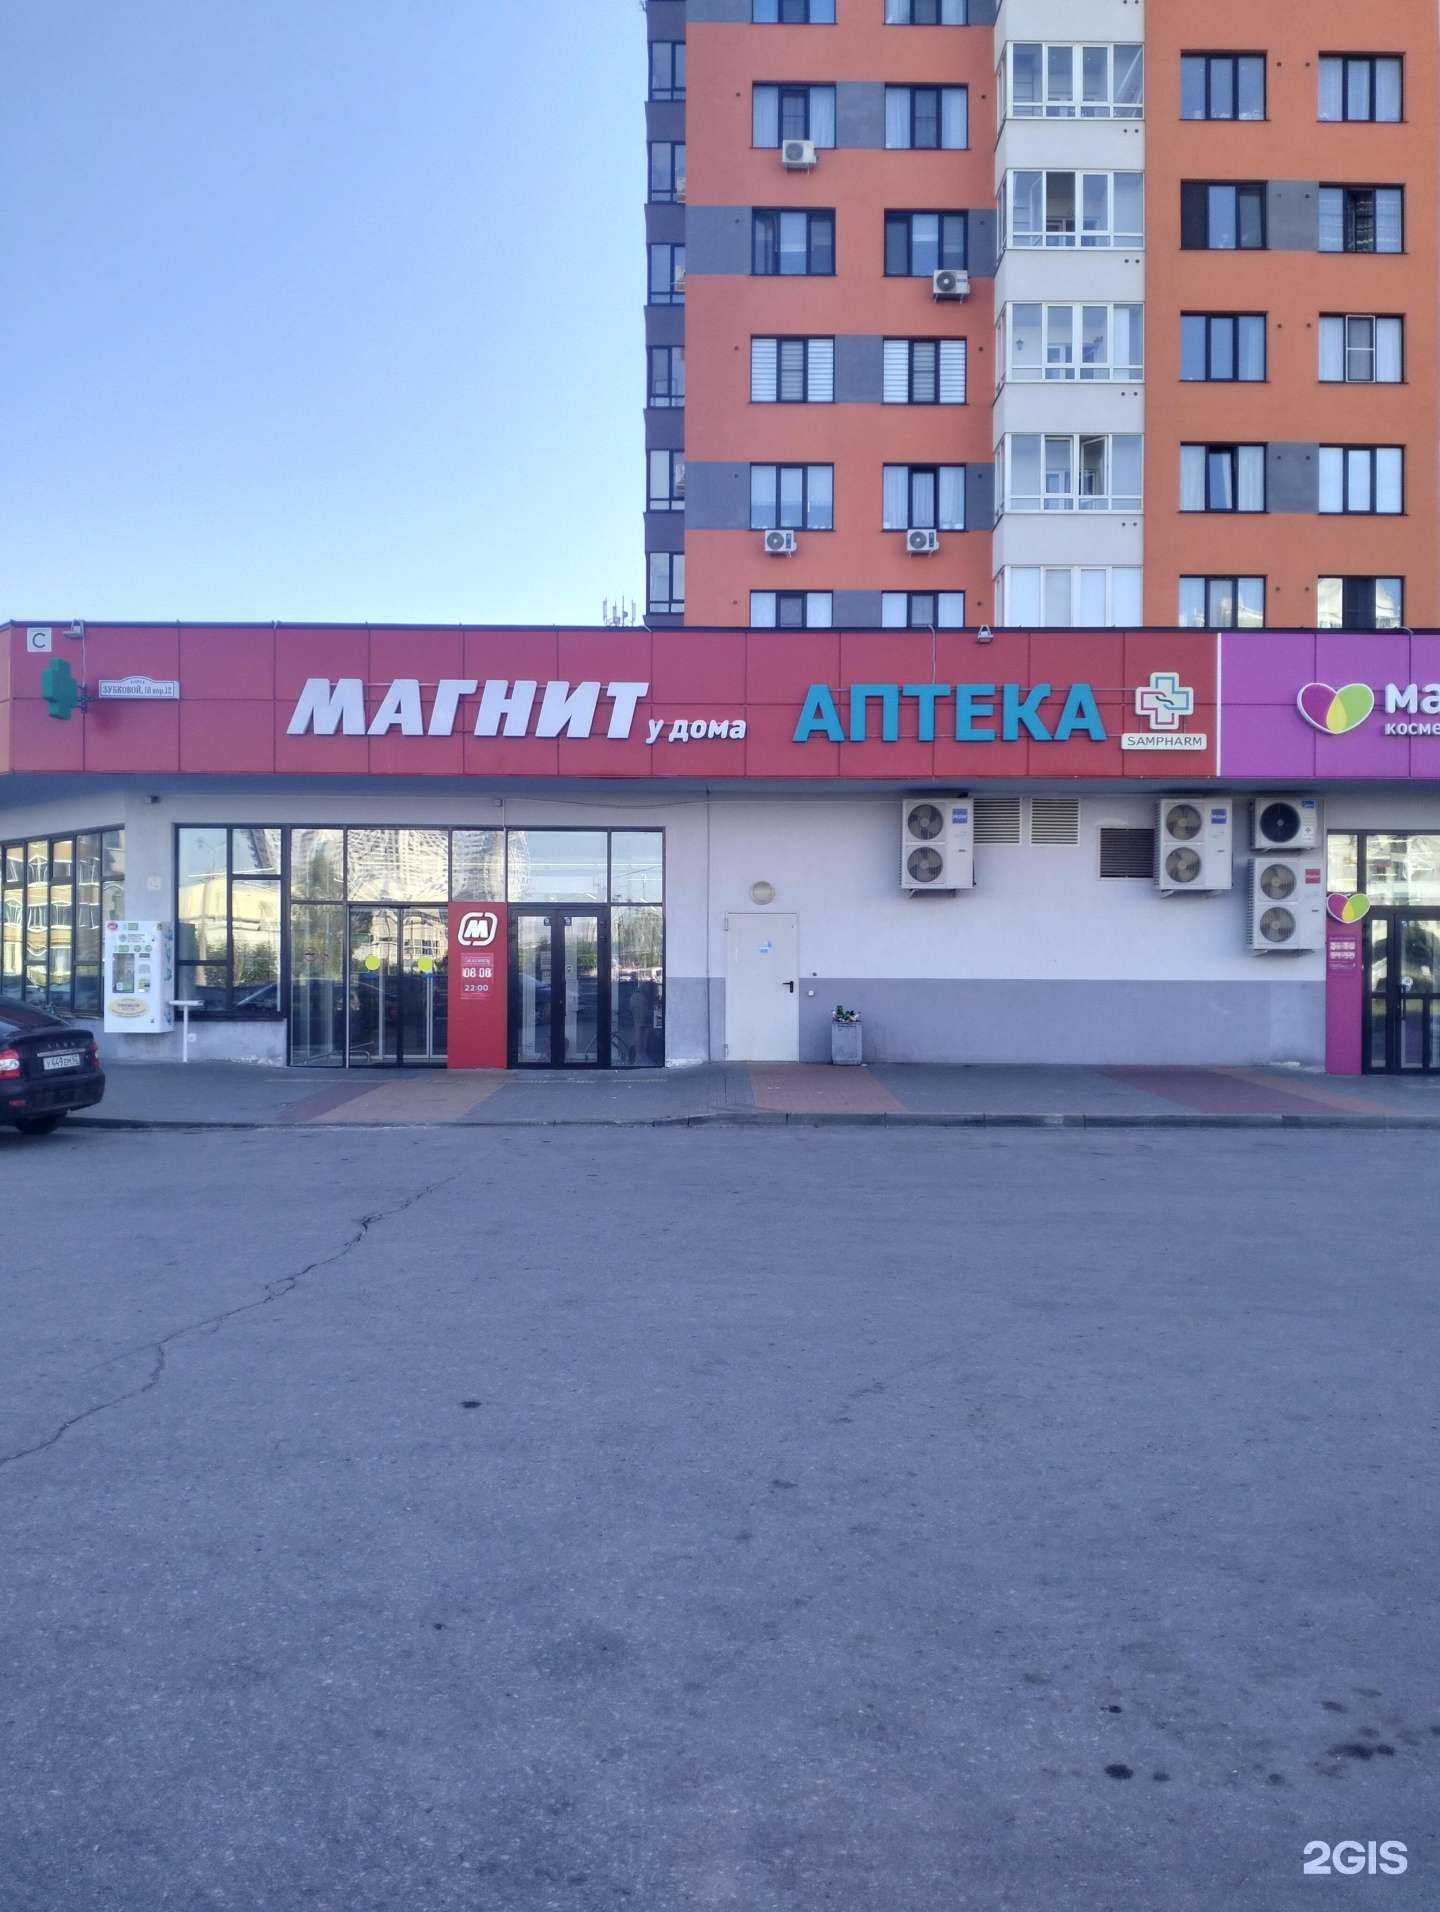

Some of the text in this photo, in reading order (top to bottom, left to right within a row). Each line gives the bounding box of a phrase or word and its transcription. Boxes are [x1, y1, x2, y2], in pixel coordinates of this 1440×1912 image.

[286, 677, 650, 740] МАГНИТ
[791, 683, 1108, 743] АПТЕКА
[645, 719, 747, 745] у дома
[1127, 735, 1203, 747] SAMPHARM
